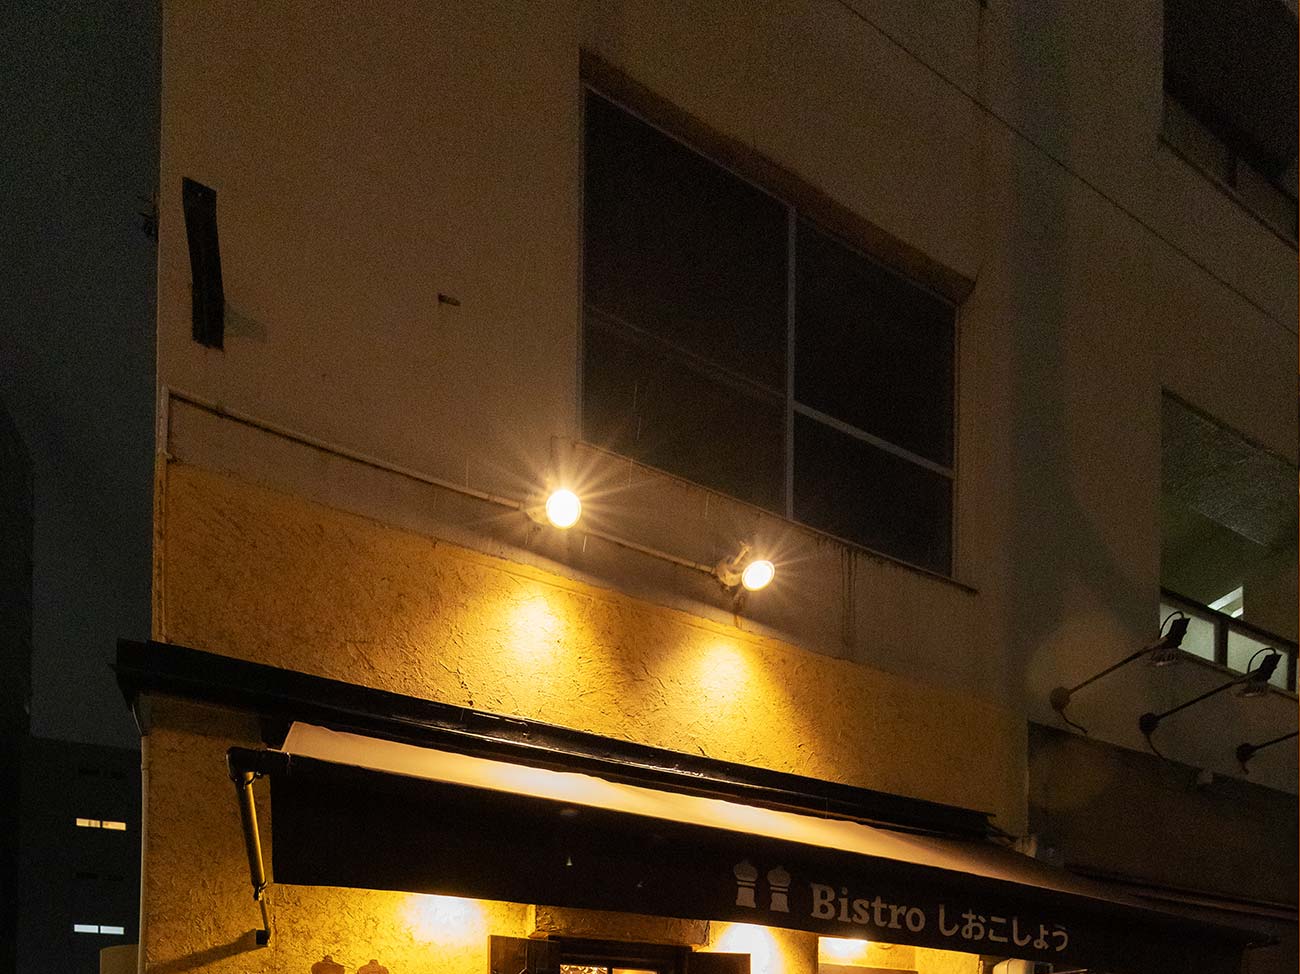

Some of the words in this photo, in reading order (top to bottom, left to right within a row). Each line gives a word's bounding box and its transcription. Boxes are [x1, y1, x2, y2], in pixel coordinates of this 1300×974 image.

[810, 883, 926, 932] Bistro
[938, 904, 1068, 951] しおこしょう
